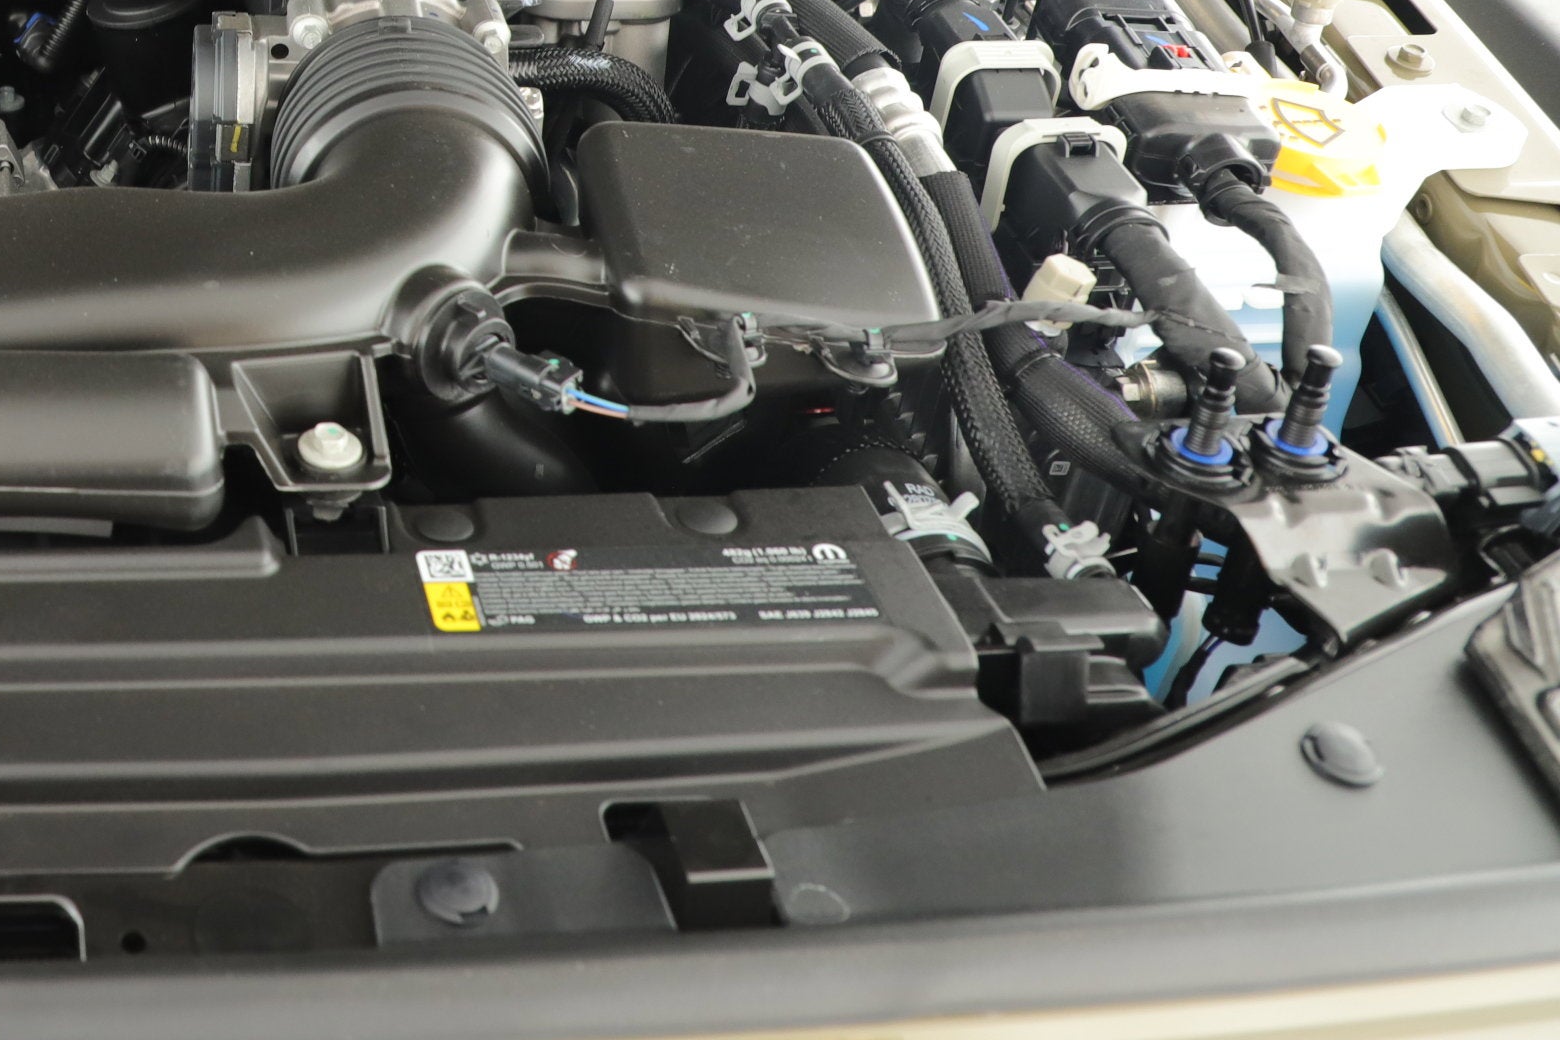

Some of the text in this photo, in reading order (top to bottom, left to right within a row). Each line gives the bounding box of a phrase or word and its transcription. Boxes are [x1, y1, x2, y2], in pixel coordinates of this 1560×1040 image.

[904, 483, 935, 497] RAD
[583, 614, 611, 624] GWP
[758, 610, 784, 620] SAE
